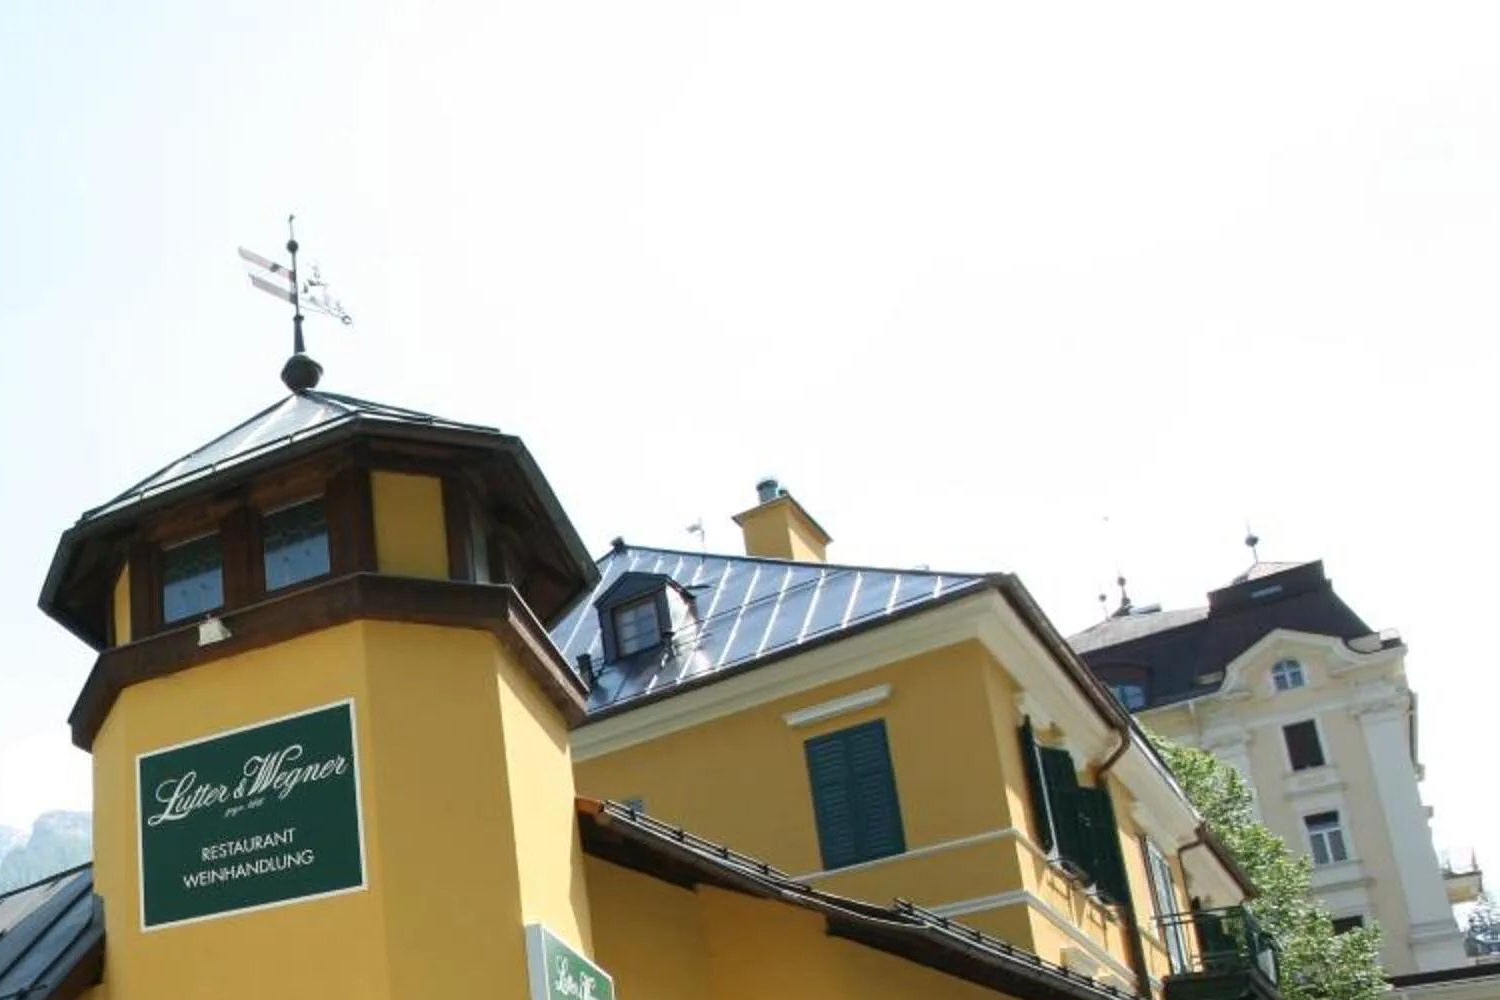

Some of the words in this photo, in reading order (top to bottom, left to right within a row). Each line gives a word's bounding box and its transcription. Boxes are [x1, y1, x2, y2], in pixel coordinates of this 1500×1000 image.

[148, 771, 230, 826] Lutter
[233, 776, 246, 799] &
[244, 744, 347, 801] Wegner
[201, 828, 296, 862] RESTAURANT
[183, 849, 315, 888] WEINHANDLUNG
